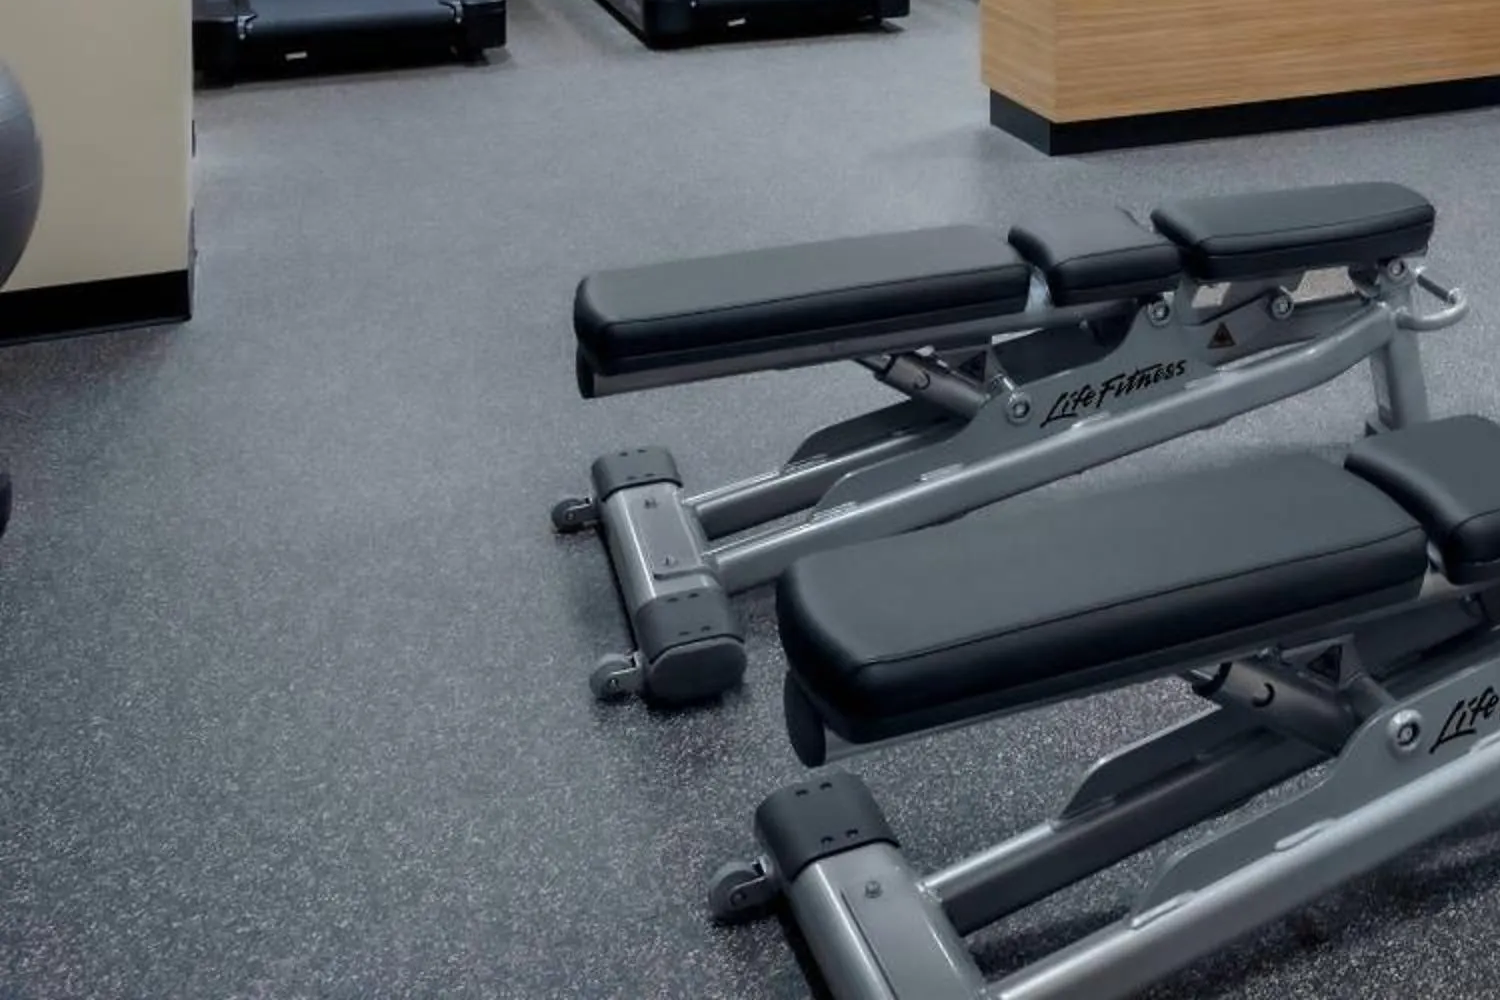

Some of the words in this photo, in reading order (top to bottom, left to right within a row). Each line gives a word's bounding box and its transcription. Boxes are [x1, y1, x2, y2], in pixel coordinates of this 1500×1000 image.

[1040, 384, 1097, 429] Life
[1098, 359, 1187, 408] Fitness
[1428, 686, 1500, 754] Life
